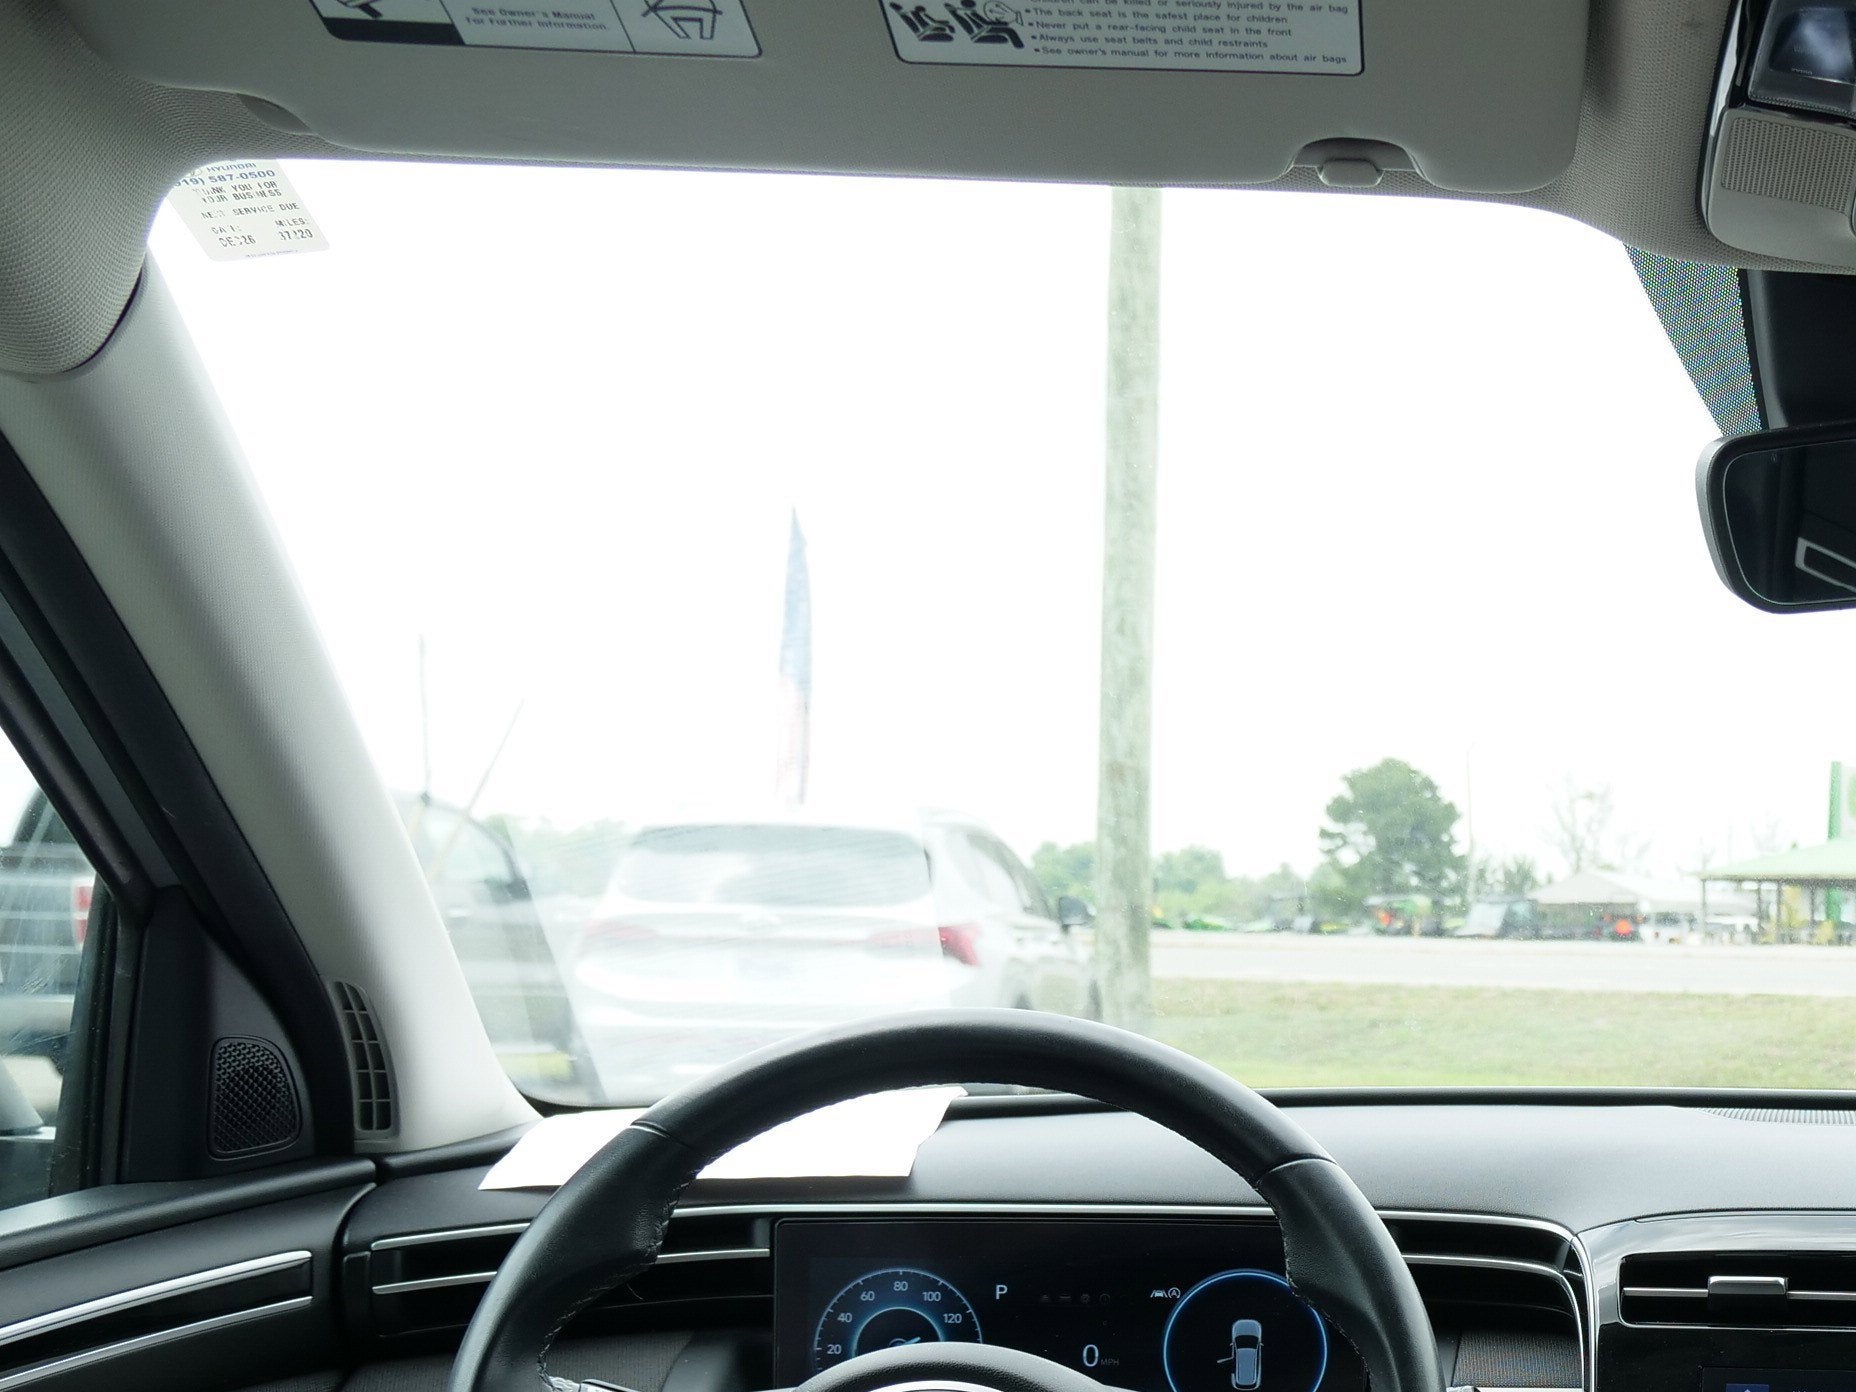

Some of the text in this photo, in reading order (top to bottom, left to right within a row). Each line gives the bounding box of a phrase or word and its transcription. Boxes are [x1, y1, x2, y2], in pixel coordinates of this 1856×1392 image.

[1176, 0, 1221, 9] seriously
[1228, 1, 1263, 10] injured
[1269, 3, 1281, 12] by
[1287, 4, 1303, 12] the
[1329, 5, 1348, 14] bag
[1034, 8, 1053, 16] The
[1058, 9, 1083, 17] back
[1090, 10, 1113, 18] seat
[1133, 11, 1149, 19] the
[1155, 12, 1188, 20] safest
[1193, 13, 1221, 22] place
[1227, 14, 1241, 22] for
[1246, 15, 1288, 24] children
[1036, 21, 1066, 29] Never
[1073, 23, 1090, 31] put
[1107, 24, 1167, 34] rear-facing
[1172, 25, 1197, 34] child
[1245, 28, 1262, 36] the
[1267, 29, 1292, 37] front
[1039, 34, 1075, 44] Always
[1104, 37, 1127, 45] seat
[1132, 37, 1158, 45] belts
[1164, 38, 1183, 46] and
[1188, 39, 1213, 47] child
[1218, 40, 1268, 49] restraints
[1042, 47, 1062, 55] See
[1111, 49, 1149, 58] manual
[1154, 49, 1168, 58] for
[1206, 51, 1264, 60] information
[1269, 53, 1298, 62] about
[1303, 54, 1317, 62] air
[1322, 54, 1347, 64] bags
[208, 170, 276, 183] 587-0500
[278, 202, 300, 211] DUE
[893, 1281, 908, 1291] 80
[995, 1284, 1008, 1300] P
[860, 1291, 875, 1301] 60
[922, 1291, 942, 1302] 100
[837, 1312, 853, 1323] 40
[943, 1313, 963, 1324] 120
[827, 1344, 842, 1355] 20
[1082, 1344, 1120, 1367] 0 MPH
